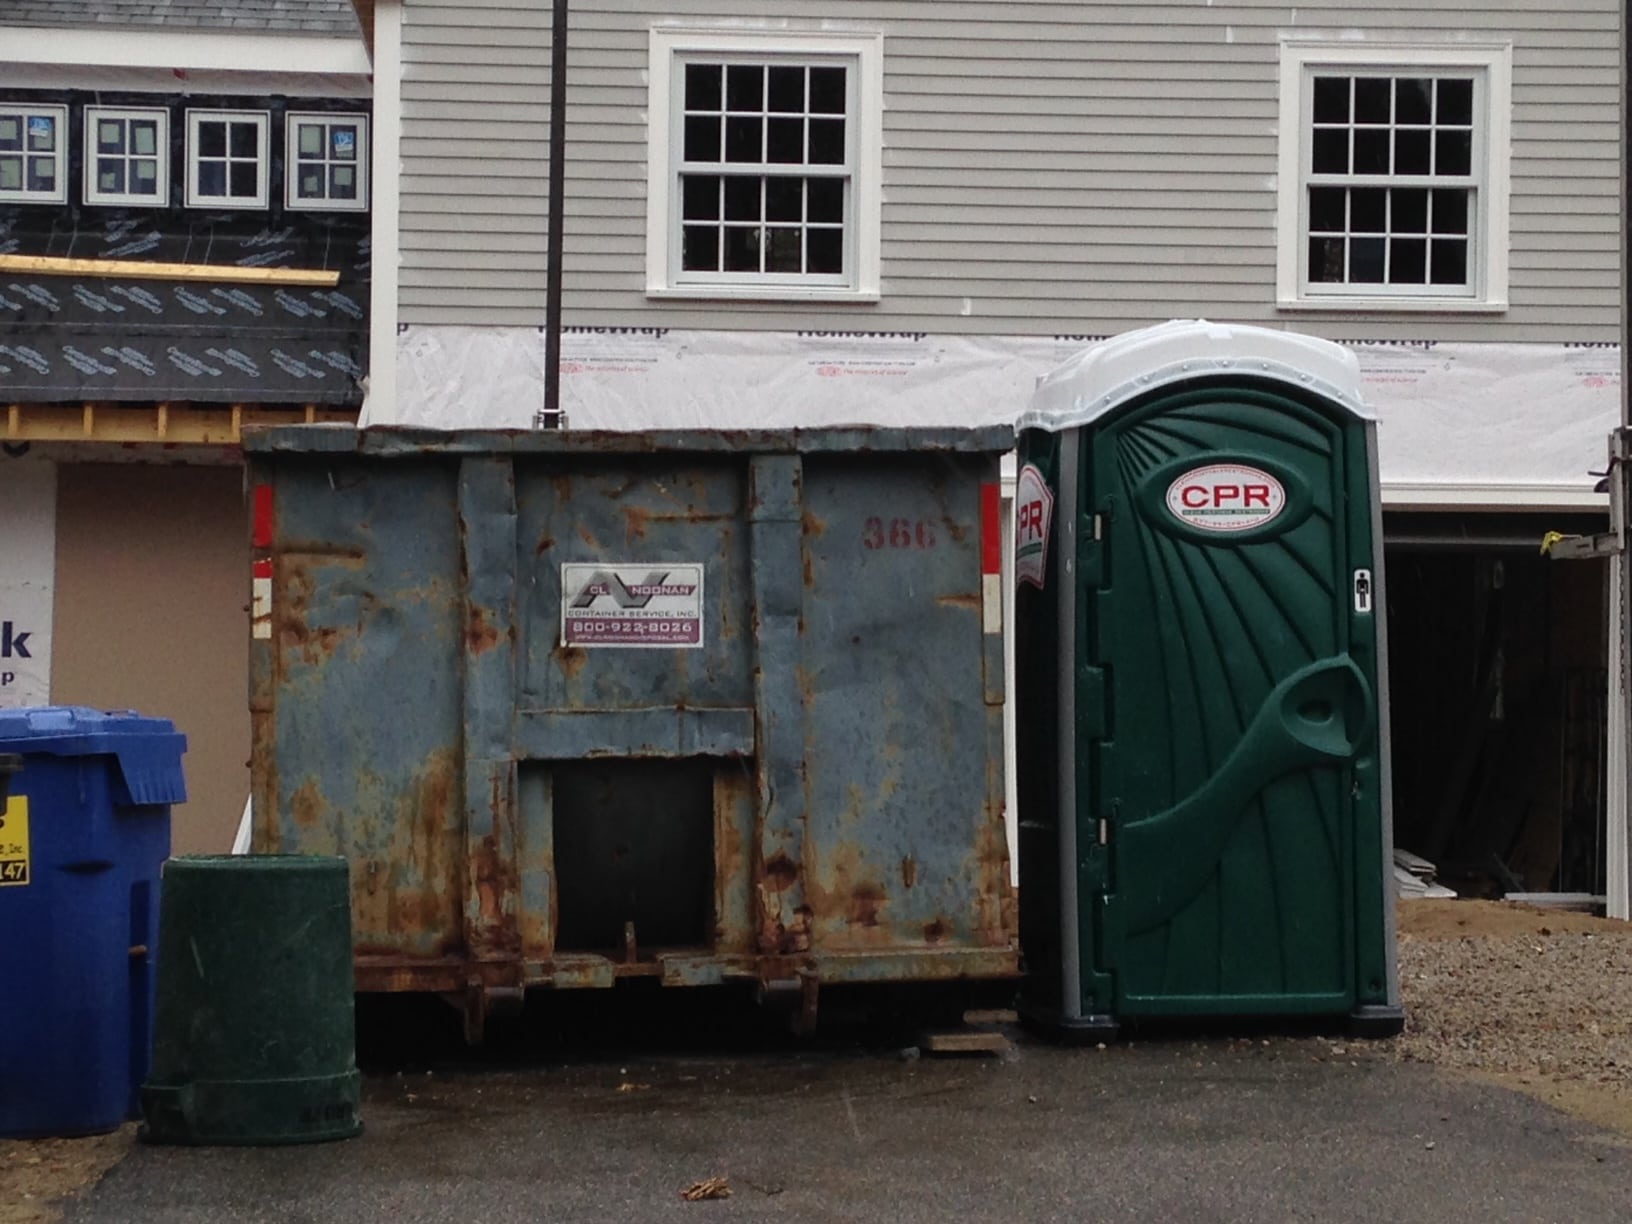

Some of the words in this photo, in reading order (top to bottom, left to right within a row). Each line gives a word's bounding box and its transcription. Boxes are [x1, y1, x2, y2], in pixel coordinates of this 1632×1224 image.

[1181, 484, 1270, 508] CPR
[863, 516, 937, 550] 366
[631, 584, 690, 596] NOONAN
[572, 621, 693, 633] 800-922-8026
